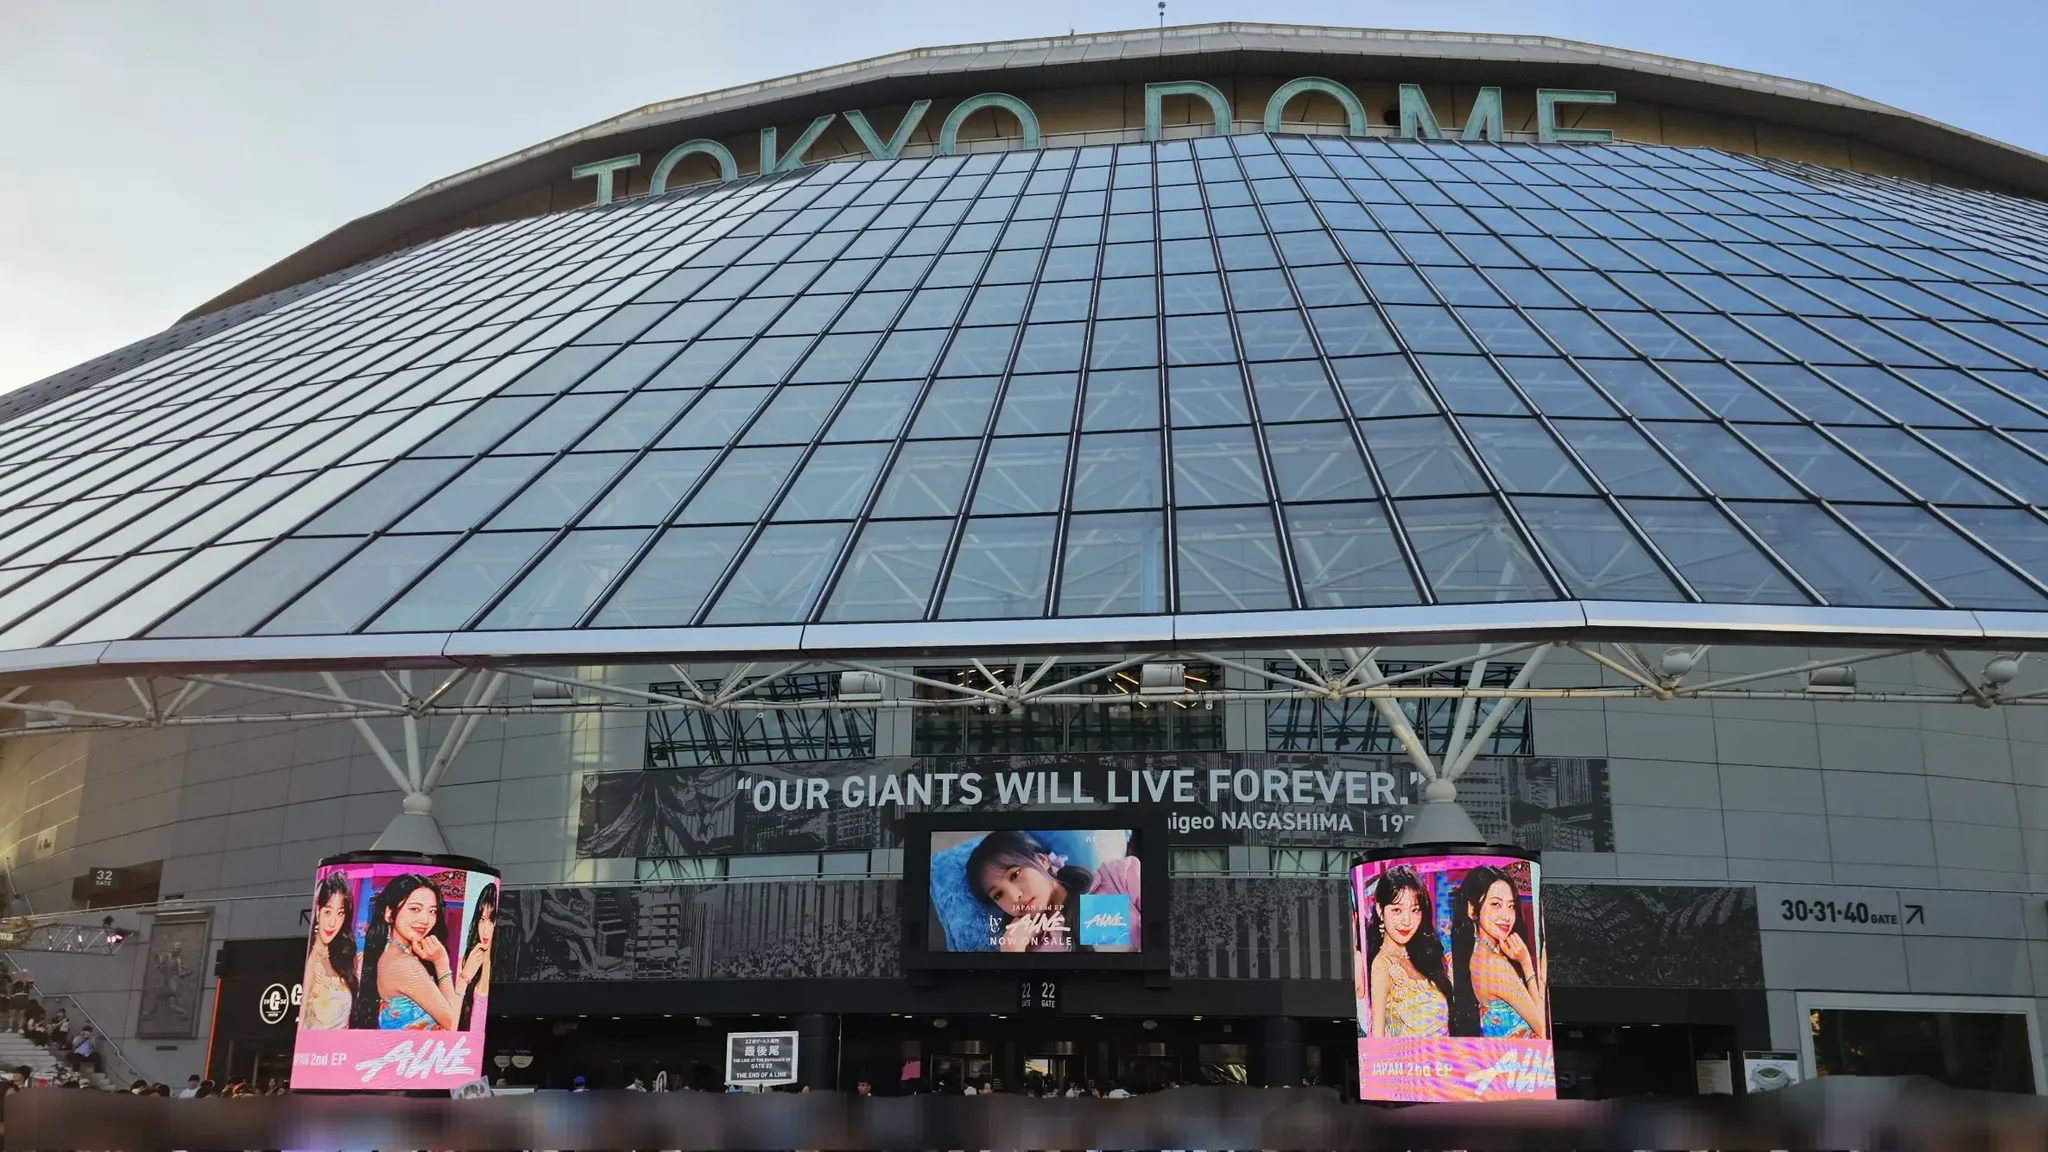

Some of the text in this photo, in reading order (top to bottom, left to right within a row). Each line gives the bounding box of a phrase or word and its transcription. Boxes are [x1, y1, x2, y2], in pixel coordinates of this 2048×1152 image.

[572, 76, 1617, 206] TOKYO DOME
[842, 772, 983, 808] GIANTS
[995, 771, 1094, 804] WILL
[1107, 769, 1195, 803] LIVE
[1221, 811, 1354, 832] NAGASHIMA
[96, 870, 113, 880] 32
[1005, 910, 1071, 935] ALIVE
[1084, 912, 1127, 929] ALIVE
[1871, 914, 1898, 924] GATE
[990, 937, 1072, 946] NOW ON SALE
[1021, 981, 1055, 999] 22 22
[1041, 999, 1055, 1008] GATE
[744, 1045, 780, 1057] 最後尾
[310, 1053, 328, 1067] 2nd
[332, 1052, 347, 1066] EP
[355, 1036, 474, 1083] ALIVE
[1372, 1062, 1403, 1077] JAPAN
[1435, 1061, 1453, 1077] EP
